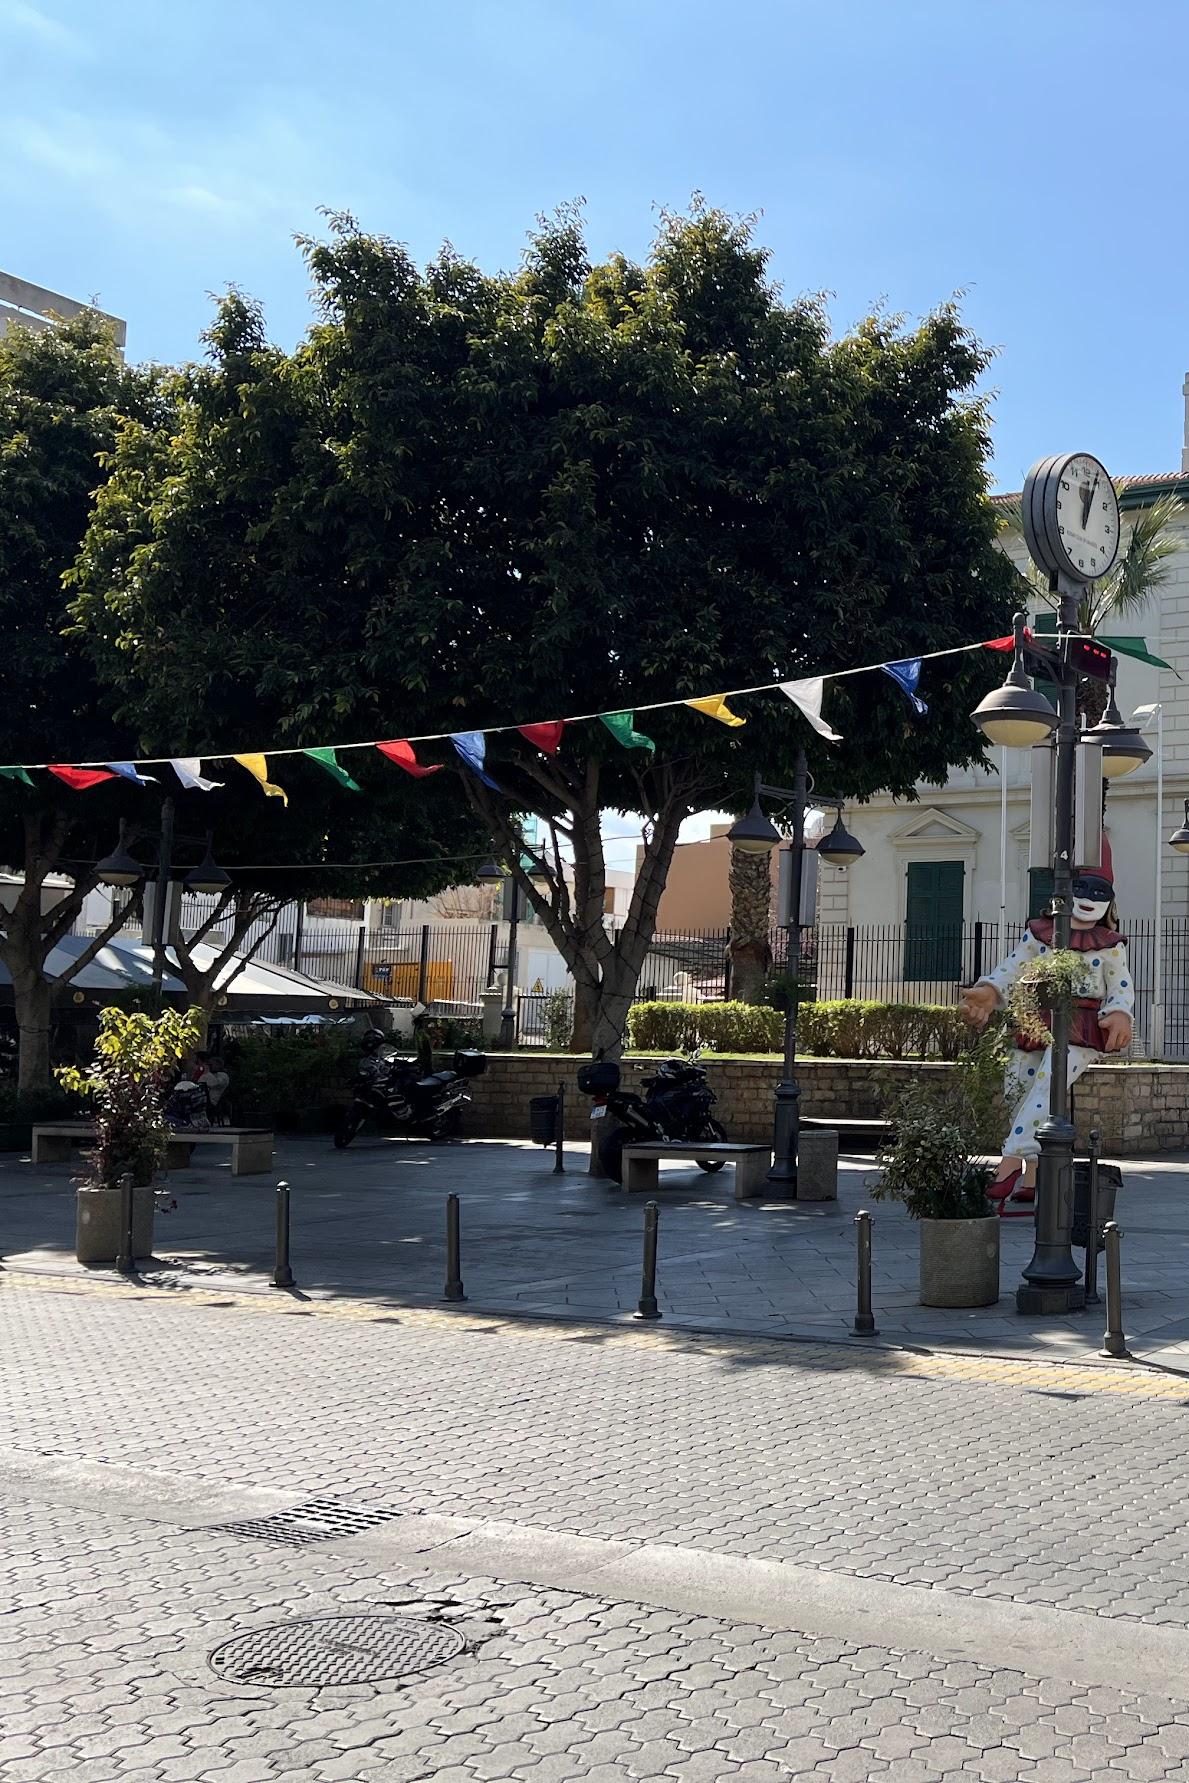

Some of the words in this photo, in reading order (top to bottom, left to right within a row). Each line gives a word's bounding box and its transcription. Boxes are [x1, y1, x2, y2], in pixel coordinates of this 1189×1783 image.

[1082, 466, 1091, 478] 12
[1061, 480, 1070, 491] 10
[1103, 502, 1108, 511] 2
[1105, 525, 1110, 534] 3
[1100, 546, 1105, 554] 4
[1079, 559, 1084, 568] 6
[1090, 558, 1096, 567] 5
[1060, 850, 1069, 860] 4
